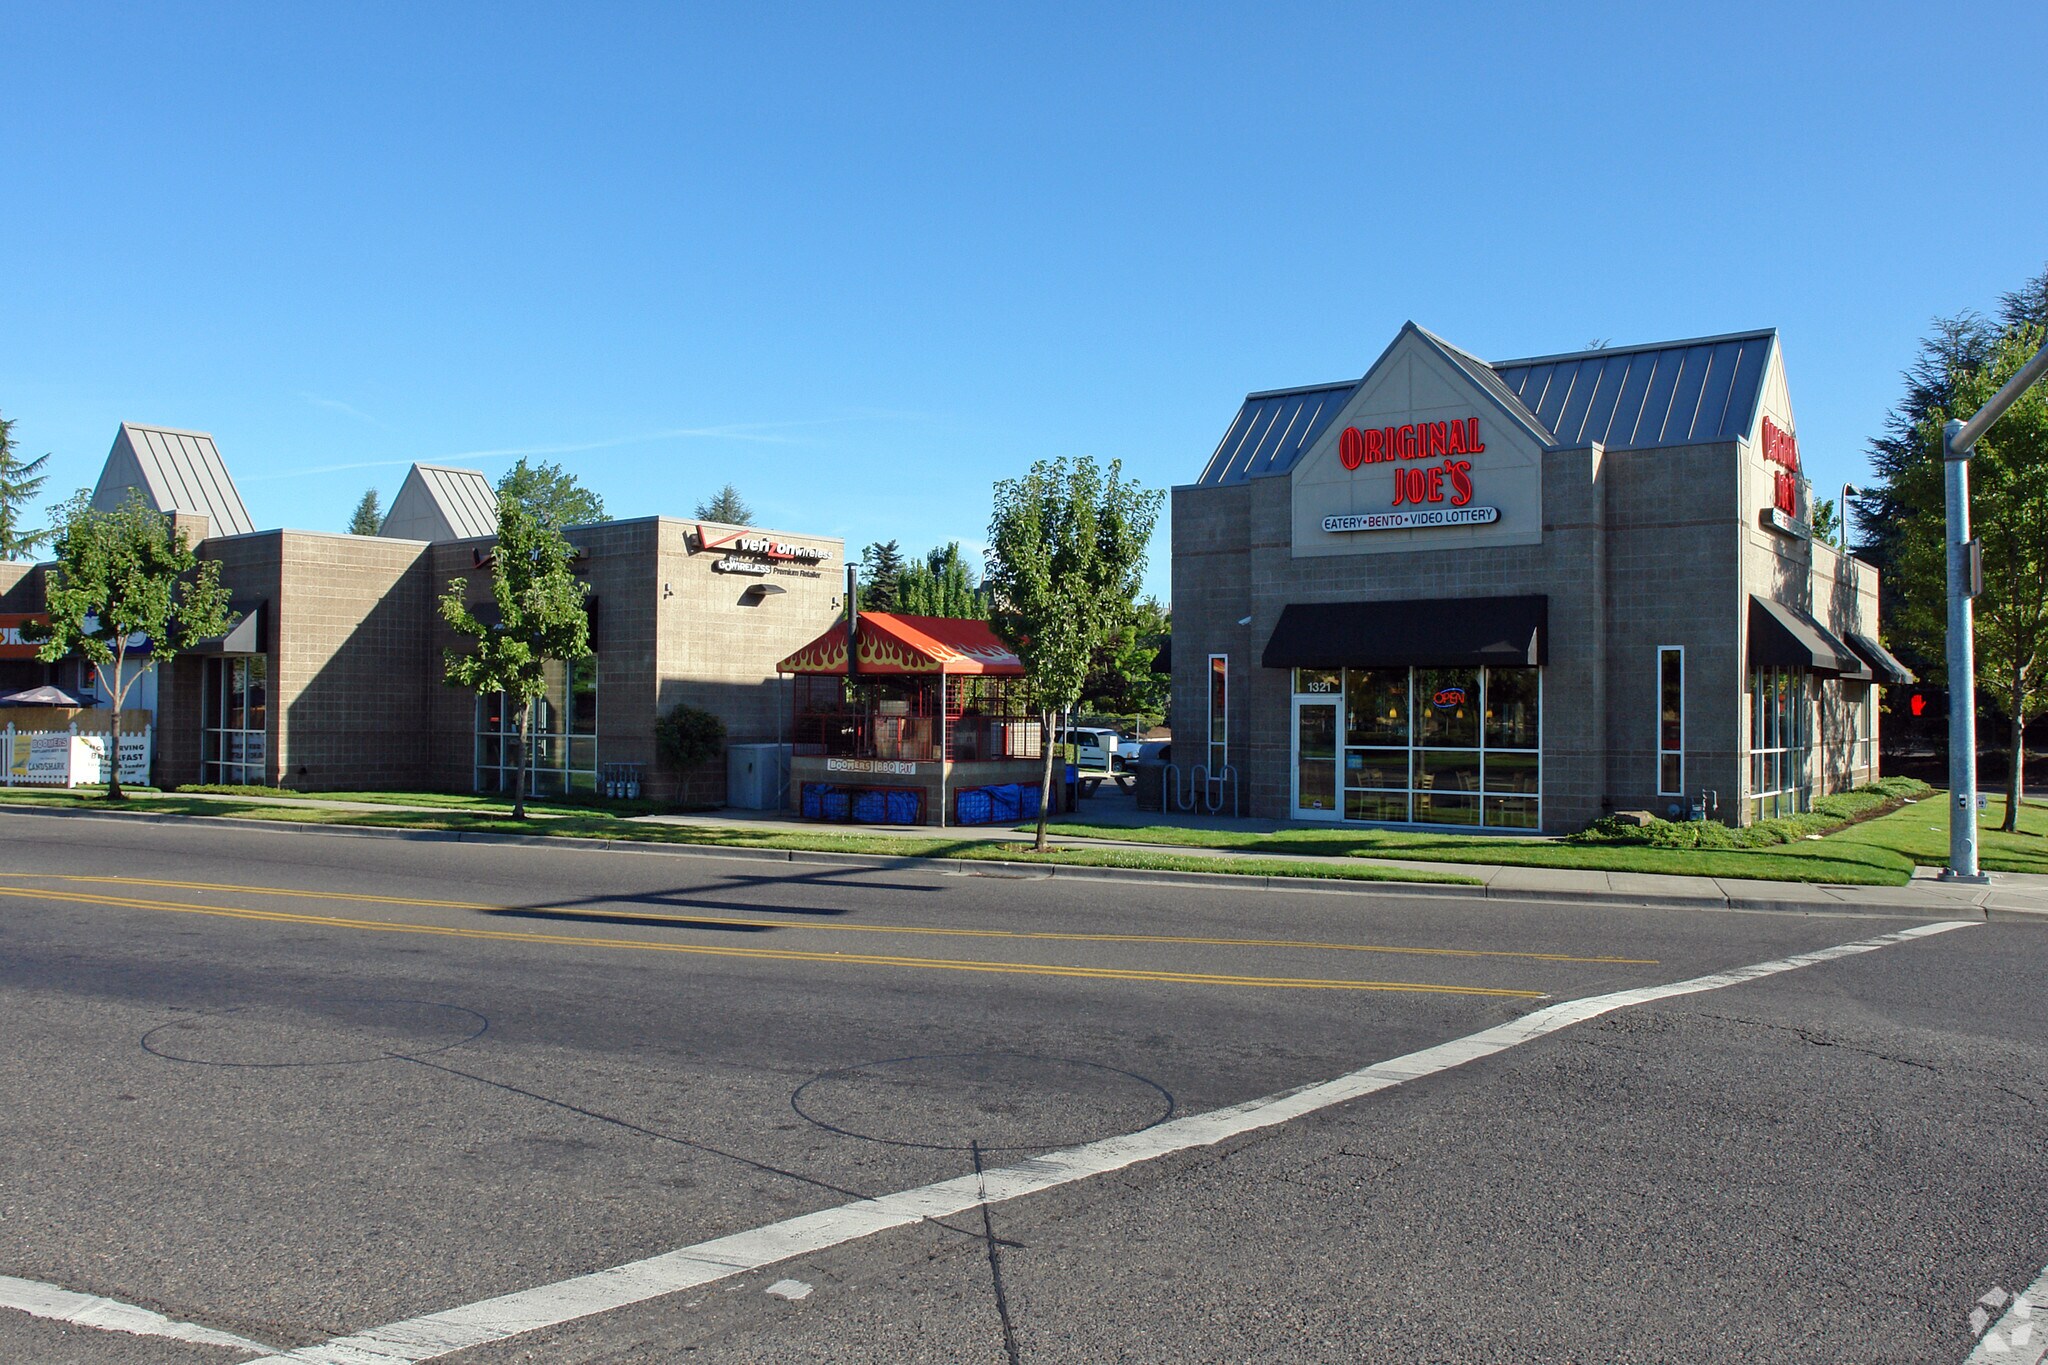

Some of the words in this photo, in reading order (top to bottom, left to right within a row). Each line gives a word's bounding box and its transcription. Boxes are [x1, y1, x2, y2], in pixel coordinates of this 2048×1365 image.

[1339, 417, 1486, 471] ORIGINAL
[1392, 459, 1473, 507] JOE'S
[1325, 517, 1363, 530] EATERY
[1368, 515, 1403, 528] BENTO
[1410, 512, 1444, 525] VIDEO
[1446, 509, 1493, 523] LOTTERY
[773, 568, 799, 577] Premium
[800, 570, 822, 579] Retailer
[1307, 682, 1332, 693] 1321
[1433, 691, 1466, 705] OPEN
[830, 759, 871, 771] BOOMERS
[877, 760, 896, 772] BBQ
[899, 762, 912, 773] PIT
